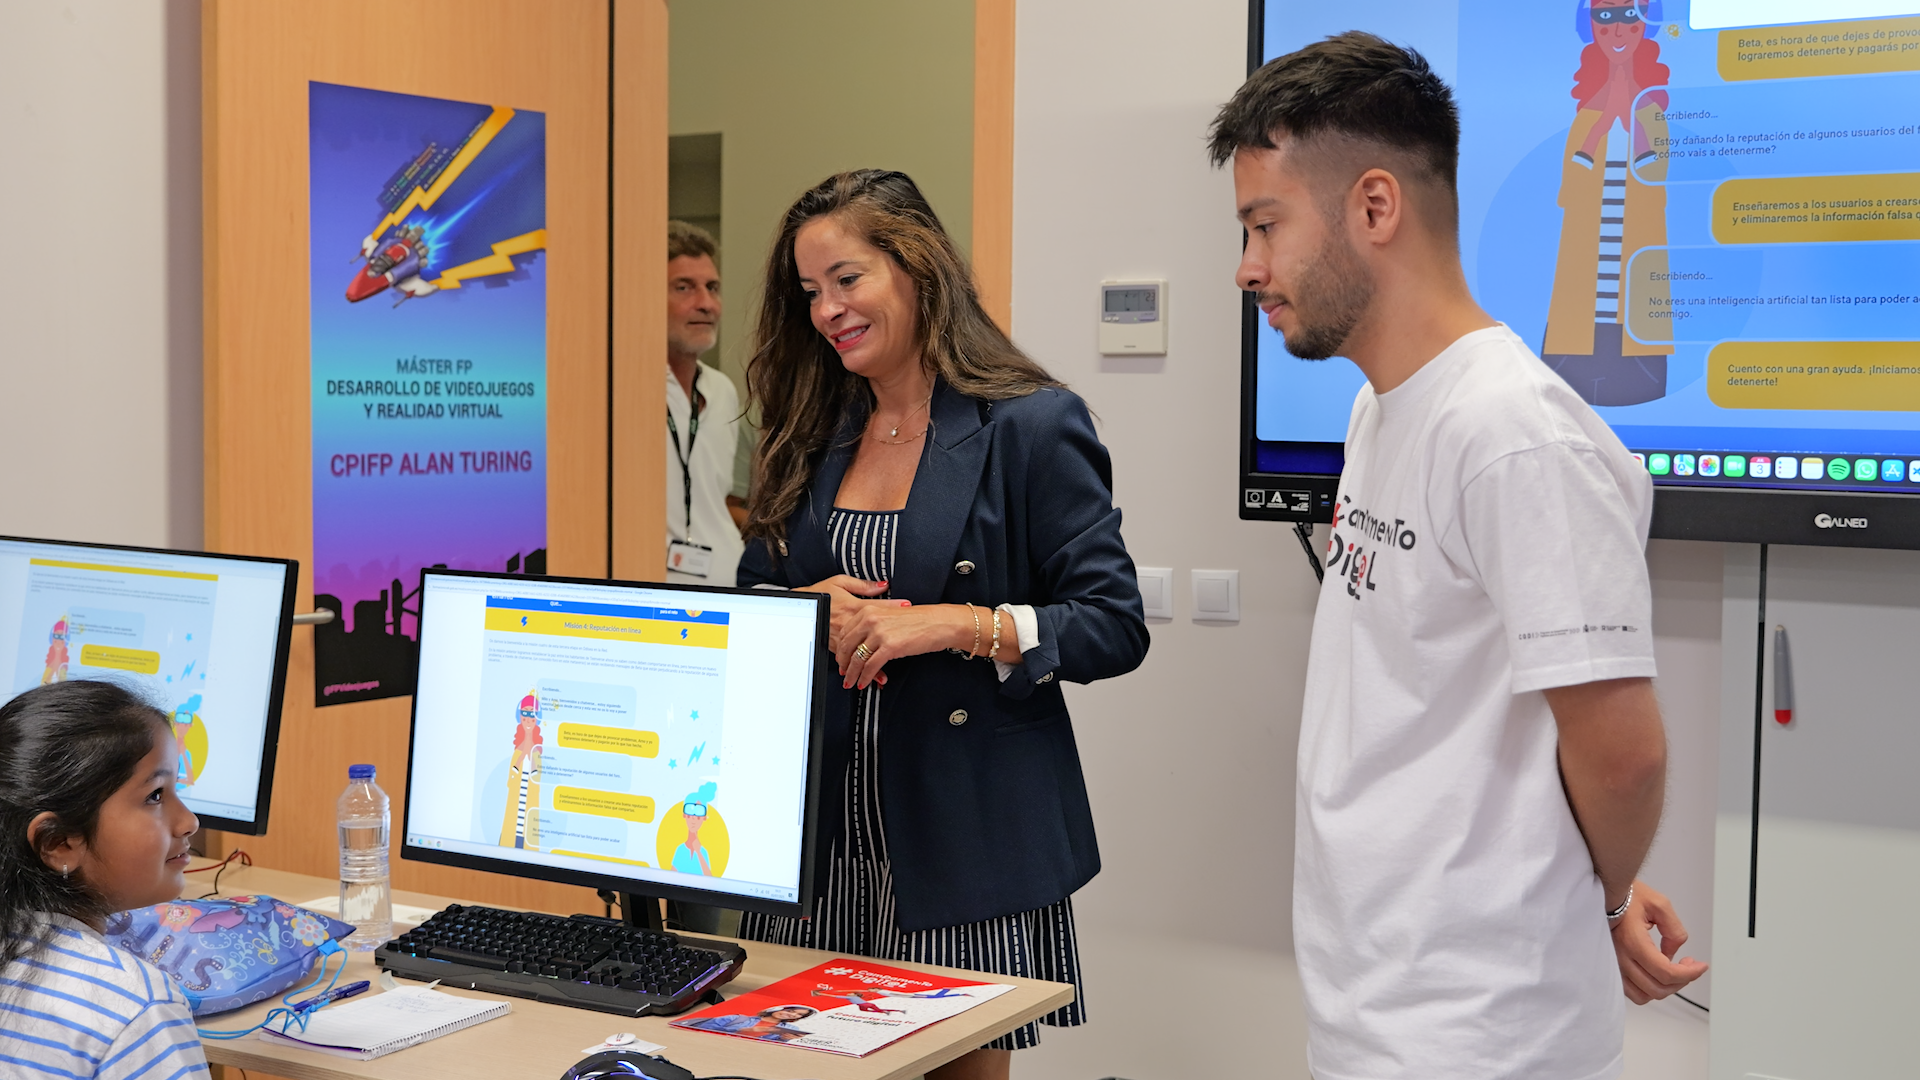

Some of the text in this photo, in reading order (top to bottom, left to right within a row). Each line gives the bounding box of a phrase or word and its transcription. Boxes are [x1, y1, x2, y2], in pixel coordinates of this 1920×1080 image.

[1738, 39, 1763, 48] Beta,
[1781, 36, 1802, 45] hora
[1806, 34, 1818, 43] de
[1821, 35, 1839, 44] que
[1842, 32, 1869, 42] dejes
[1873, 30, 1885, 39] de
[1738, 42, 1919, 62] lograremos detenerte y pagarás por
[1655, 110, 1718, 121] Escribiendo...
[1654, 125, 1914, 147] Estoy dañando la reputación de algunos usuarios del
[1688, 148, 1706, 158] vais
[1718, 145, 1776, 156] detenerme?
[1733, 201, 1800, 211] Enseñaremos
[1812, 200, 1826, 208] los
[1830, 199, 1873, 208] usuarios
[1733, 216, 1738, 226] y
[1741, 213, 1808, 223] eliminaremos
[1811, 213, 1820, 222] la
[1823, 210, 1884, 221] información
[1887, 210, 1912, 219] falsa
[1650, 272, 1713, 281] Escribiendo...
[1649, 297, 1662, 306] No
[1708, 296, 1764, 308] inteligencia
[1767, 295, 1808, 304] artificial
[1811, 296, 1827, 304] tan
[1830, 295, 1851, 304] lista
[1854, 296, 1877, 306] para
[1880, 294, 1909, 305] poder
[1648, 310, 1692, 320] conmigo.
[396, 355, 472, 375] MÁSTER FP
[1728, 364, 1762, 373] Cuento
[1807, 366, 1830, 375] gran
[1832, 365, 1865, 375] ayuda.
[1727, 377, 1778, 386] detenerte!
[327, 380, 534, 397] DESARROLLO DE VIDEOJUEGOS
[364, 404, 502, 418] Y REALIDAD VIRTUAL
[331, 450, 532, 476] CPIFP ALAN TURING
[1756, 464, 1764, 474] 3
[564, 621, 582, 629] Misión
[589, 623, 619, 632] Reputación
